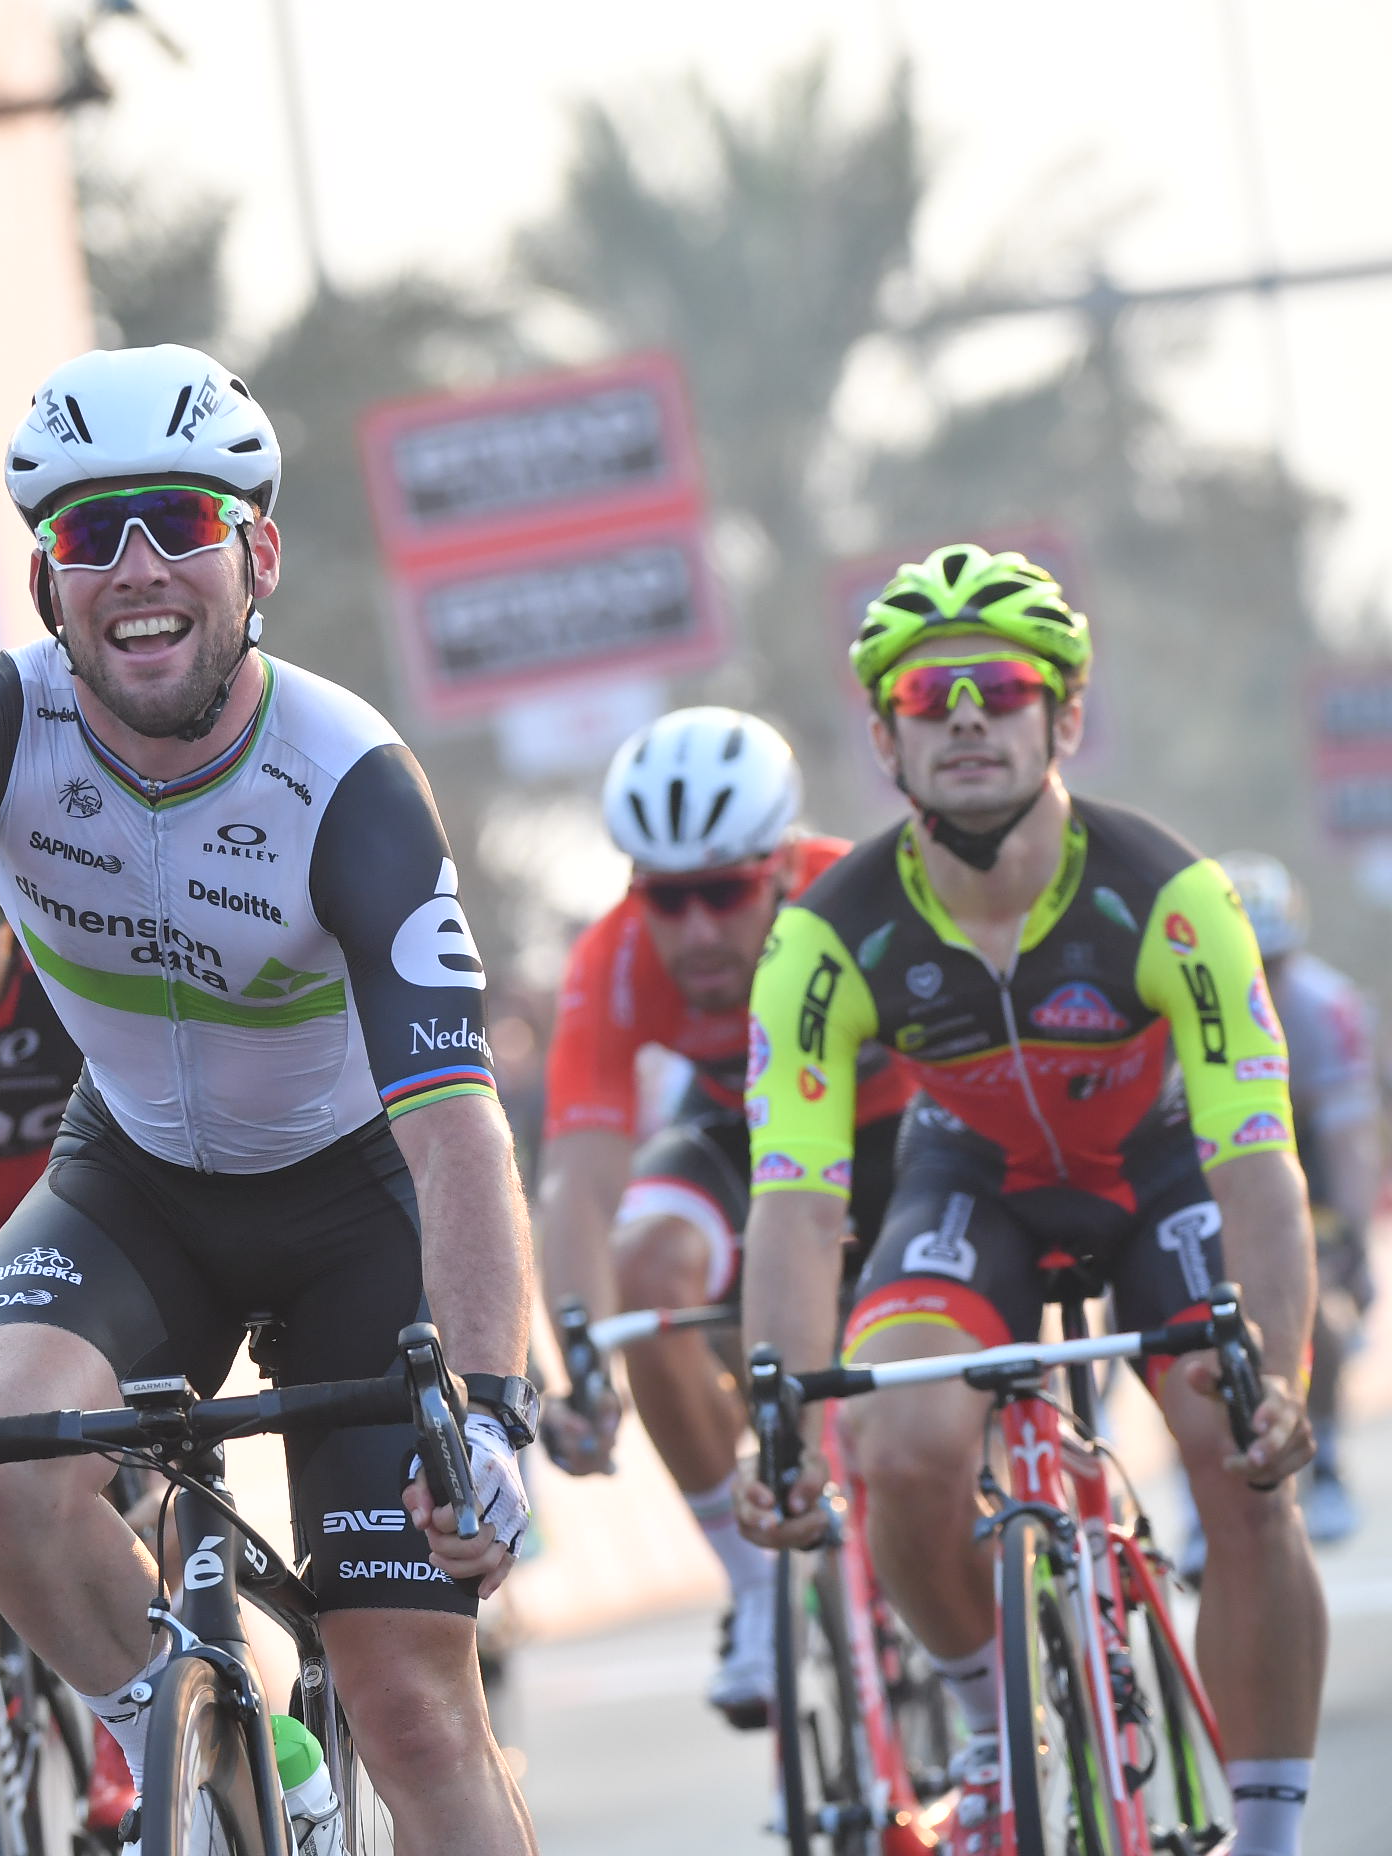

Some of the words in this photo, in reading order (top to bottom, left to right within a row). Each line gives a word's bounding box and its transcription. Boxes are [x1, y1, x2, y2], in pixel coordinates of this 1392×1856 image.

[42, 389, 80, 444] MET
[181, 374, 217, 443] MET
[29, 831, 106, 870] SAPINDA
[203, 843, 277, 863] OAKLEY
[15, 874, 223, 968] dimension
[130, 941, 229, 993] data
[134, 1382, 172, 1391] GARMIN
[339, 1560, 446, 1582] SAPINDA
